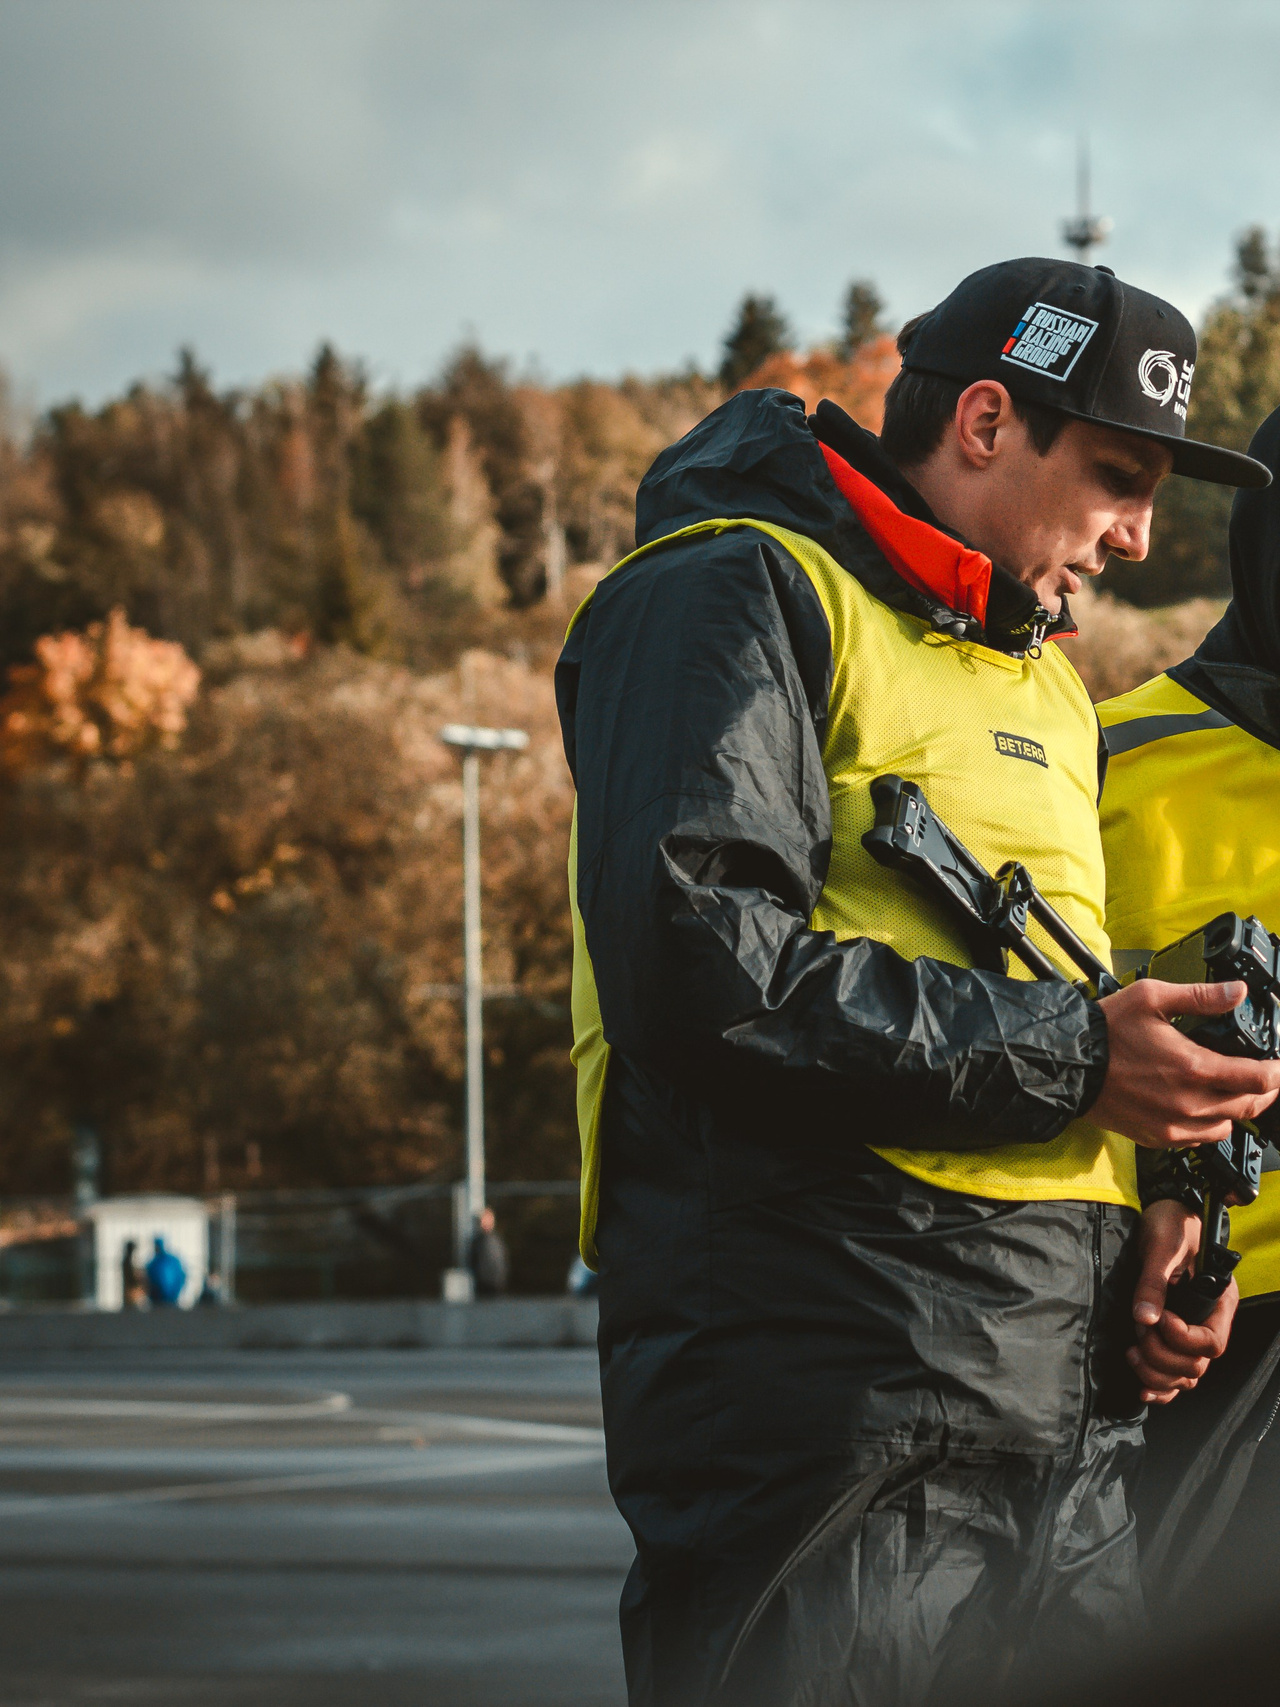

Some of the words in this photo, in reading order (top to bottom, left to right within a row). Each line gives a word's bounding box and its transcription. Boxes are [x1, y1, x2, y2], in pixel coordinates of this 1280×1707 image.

[1021, 325, 1075, 356] RACING
[1031, 308, 1090, 343] RUSSIAN
[1011, 340, 1060, 369] GROUP
